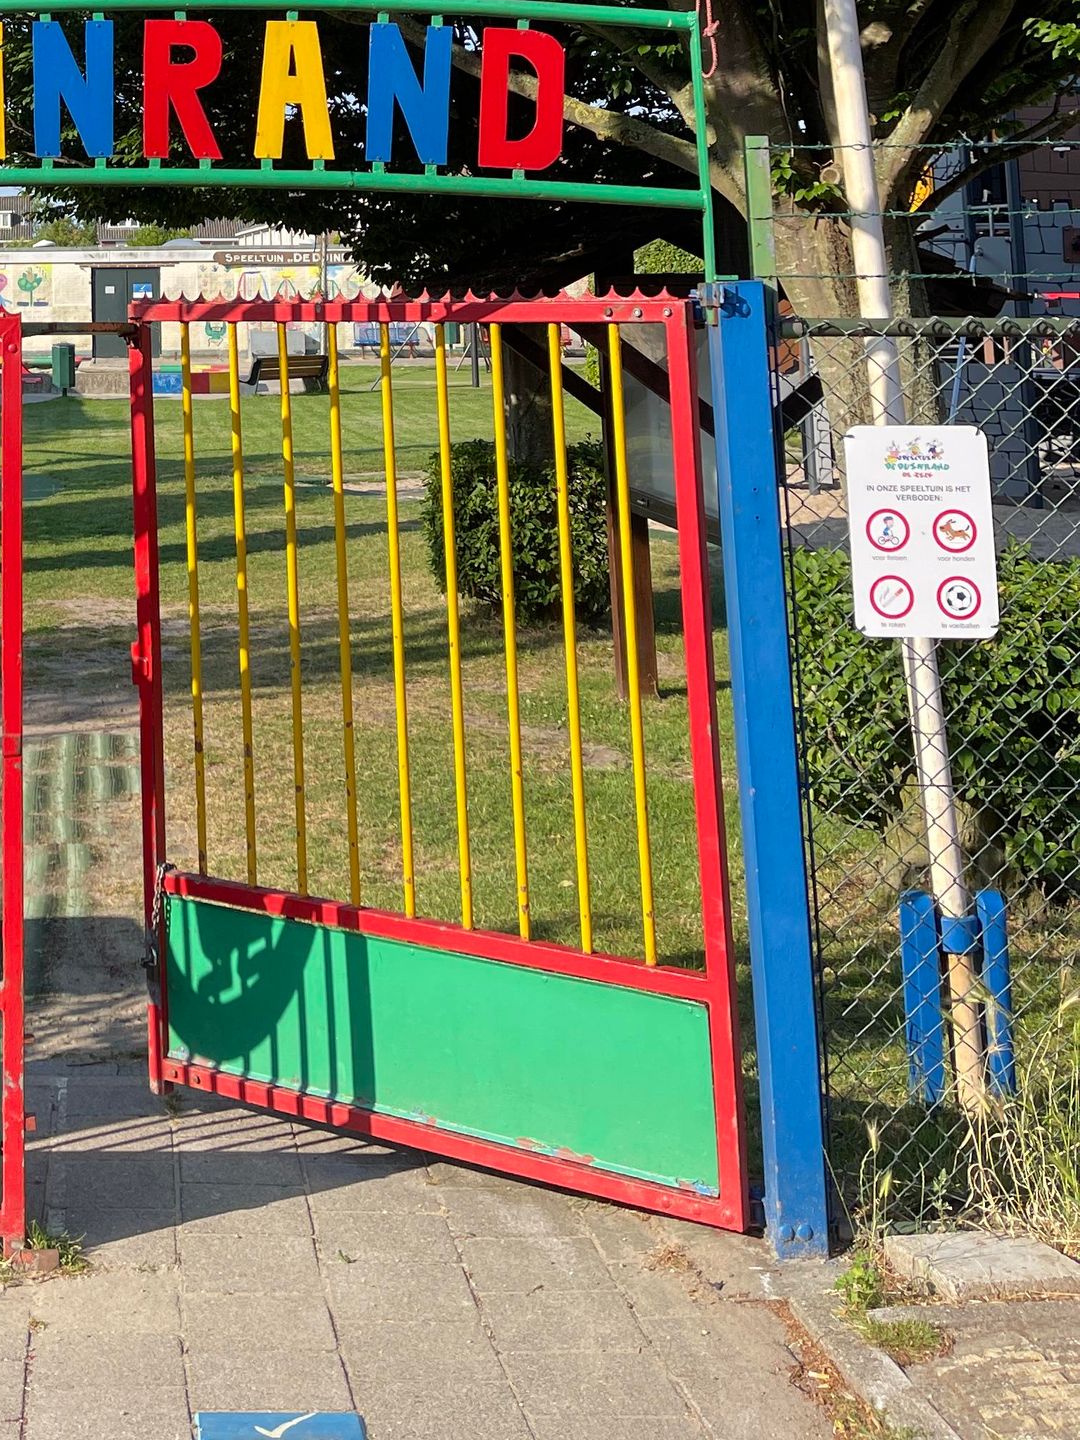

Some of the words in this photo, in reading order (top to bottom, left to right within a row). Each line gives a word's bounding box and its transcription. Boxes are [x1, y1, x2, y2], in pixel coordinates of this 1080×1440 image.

[866, 484, 875, 492] IN
[876, 484, 899, 492] ONZE
[900, 484, 944, 493] SPEELTUIN
[945, 485, 954, 493] IS
[955, 485, 971, 493] HET
[896, 494, 943, 502] VERBODEN:
